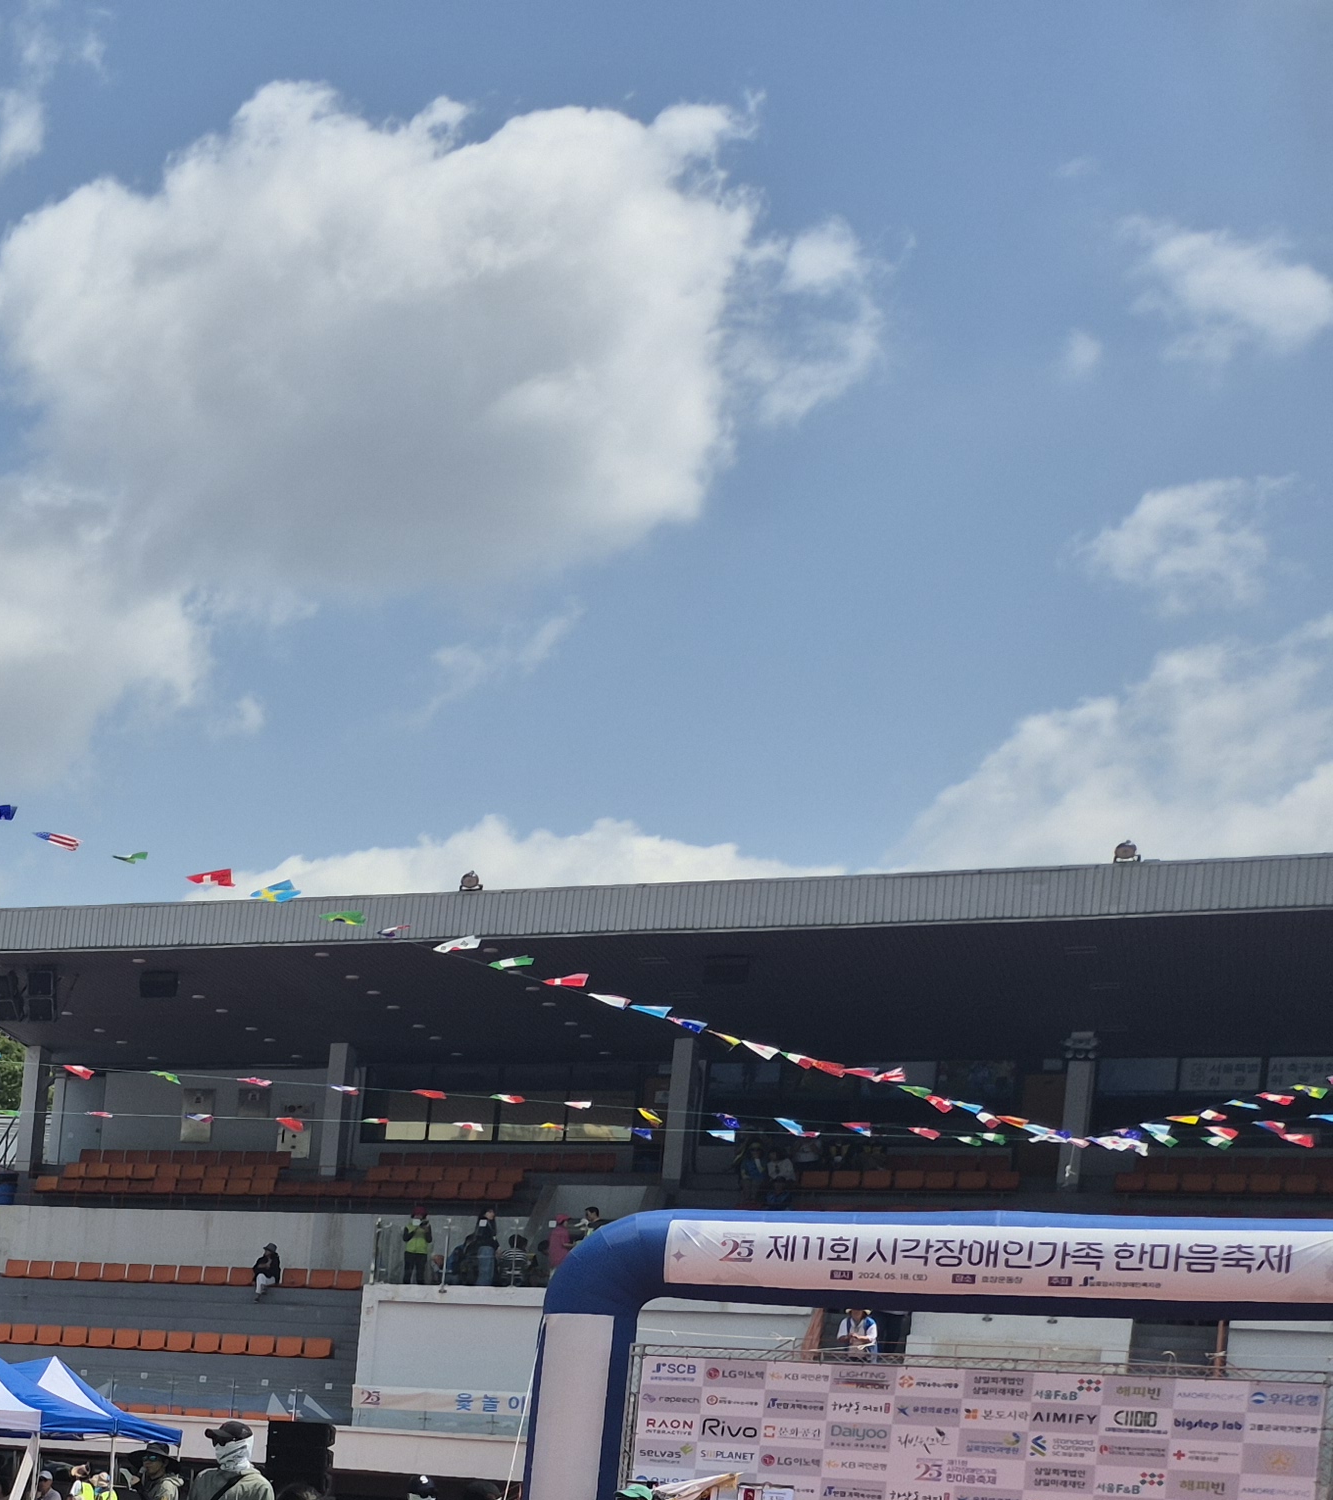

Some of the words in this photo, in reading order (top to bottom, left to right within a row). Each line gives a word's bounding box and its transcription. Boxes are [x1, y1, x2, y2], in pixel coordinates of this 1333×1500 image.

[766, 1235, 859, 1264] 제11회
[866, 1237, 1104, 1272] 시각장애인가족
[1114, 1242, 1291, 1275] 한마음축제
[858, 1271, 882, 1280] 2024.
[883, 1272, 898, 1280] 05.
[899, 1273, 911, 1281] 18.
[982, 1275, 1023, 1285] 효창운동장
[667, 1363, 696, 1374] SCB
[784, 1373, 799, 1381] KB
[839, 1371, 885, 1380] LIGHTING
[974, 1376, 1024, 1386] 삼일회계법인
[973, 1387, 1024, 1396] 삼일미래재단
[1034, 1390, 1078, 1401] 서울F&B
[1116, 1386, 1161, 1401] 해피빈
[1268, 1393, 1320, 1407] 우리은행
[982, 1409, 1029, 1420] 본도시락
[1033, 1412, 1097, 1424] AIMIFY
[646, 1418, 694, 1430] RAON
[701, 1418, 757, 1438] Rivo
[1173, 1418, 1219, 1431] bigstep
[1221, 1420, 1243, 1431] lab
[830, 1424, 888, 1441] Daiyoo
[841, 1461, 856, 1469] KB
[1034, 1467, 1086, 1478] 삼일회계법인
[946, 1473, 997, 1485] 한마음축제
[1034, 1478, 1086, 1489] 삼일미래재단
[1096, 1483, 1141, 1494] 서울F&B
[1180, 1480, 1225, 1496] 해피빈
